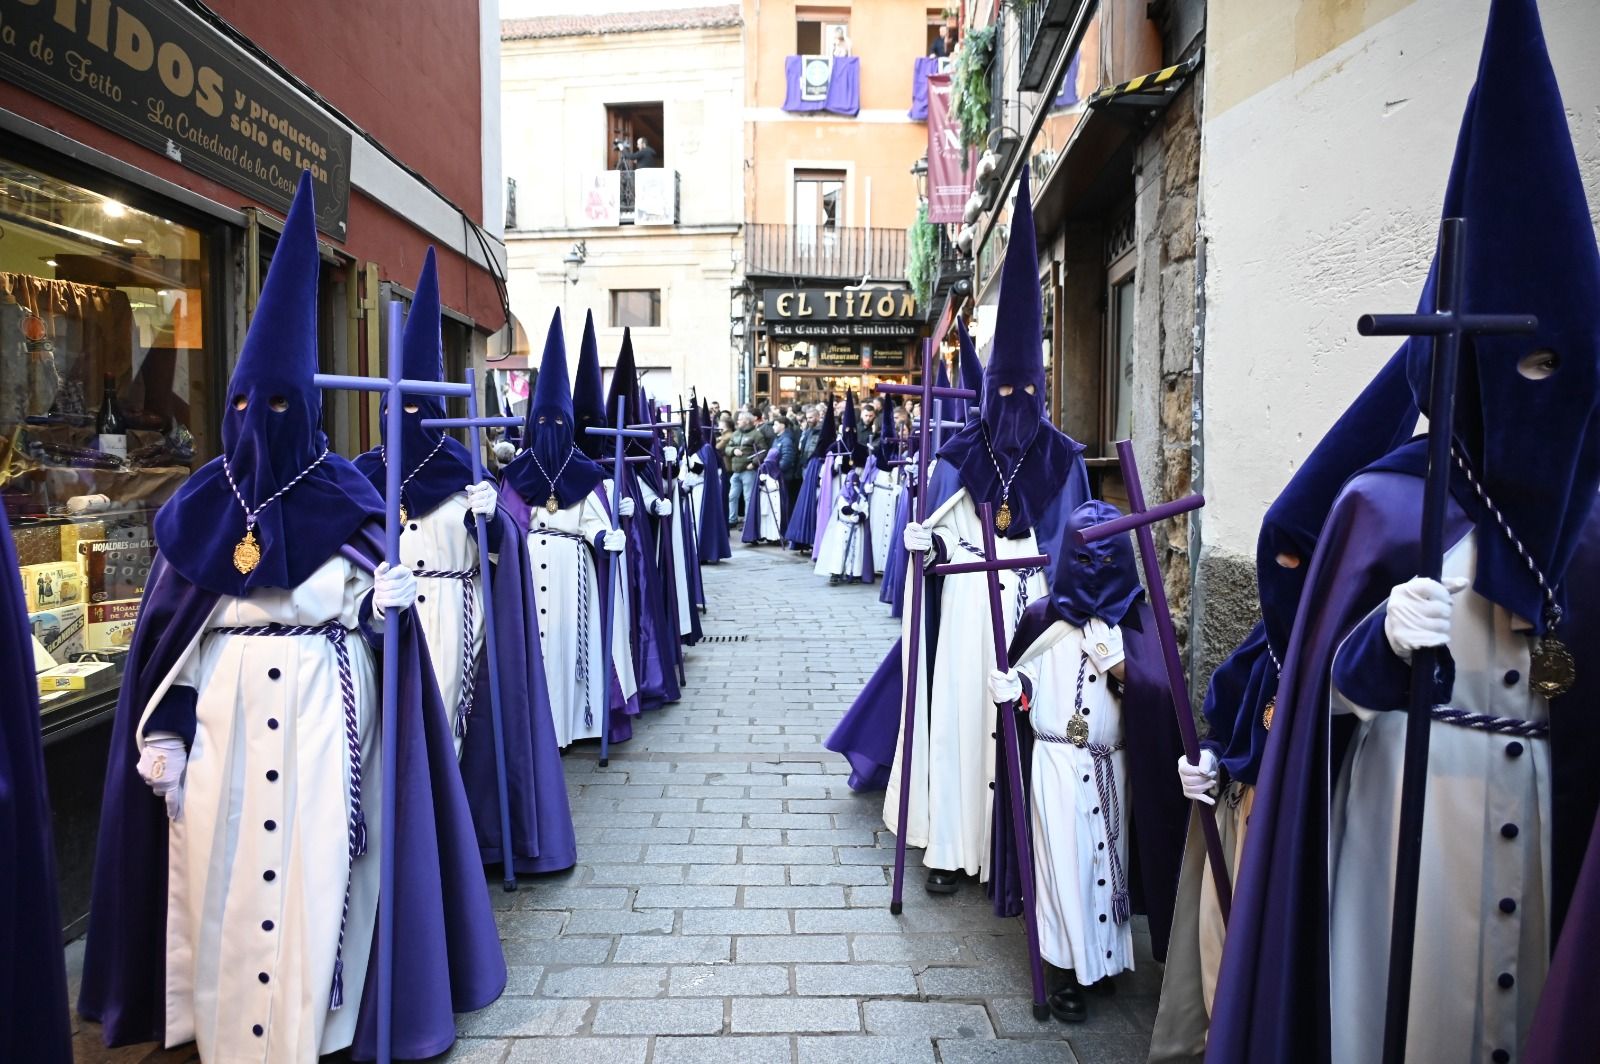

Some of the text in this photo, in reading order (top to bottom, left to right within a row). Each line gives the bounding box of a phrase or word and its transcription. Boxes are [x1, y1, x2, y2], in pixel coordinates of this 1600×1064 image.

[29, 33, 54, 65] de
[65, 50, 122, 102] Feito
[147, 97, 173, 130] La
[176, 112, 238, 165] Catedral
[239, 150, 253, 173] de
[255, 158, 267, 180] la
[269, 164, 297, 195] Cecin
[234, 89, 327, 161] y productos
[230, 113, 328, 184] sólo de León
[776, 292, 812, 317] EL
[774, 324, 915, 335] La Casa del Embutido
[92, 541, 129, 553] HOJALDRES
[123, 611, 139, 619] AST
